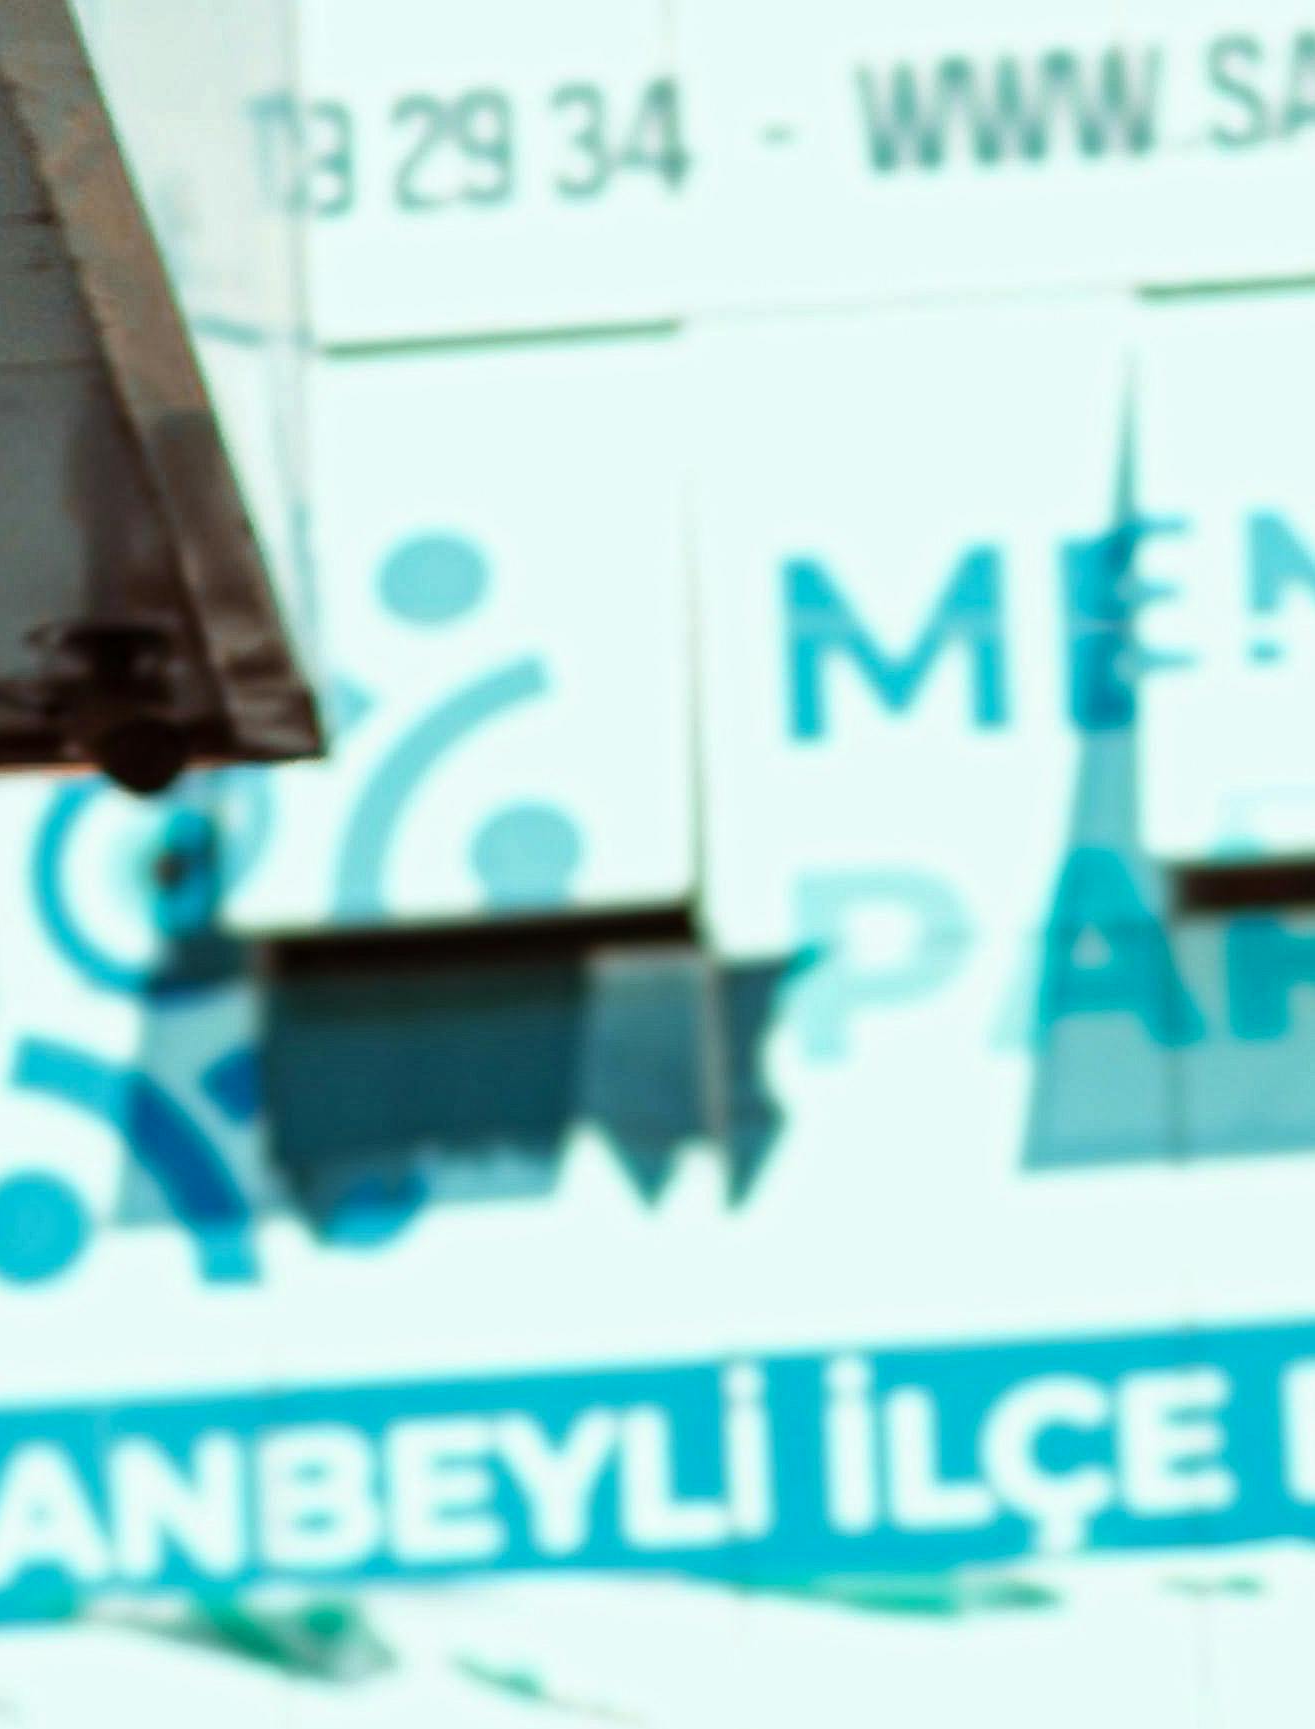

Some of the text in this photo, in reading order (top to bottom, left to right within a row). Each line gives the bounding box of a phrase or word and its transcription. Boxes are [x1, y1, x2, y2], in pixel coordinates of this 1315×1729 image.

[391, 90, 516, 213] 29
[548, 76, 690, 200] 34
[824, 1352, 1233, 1553] İLÇE
